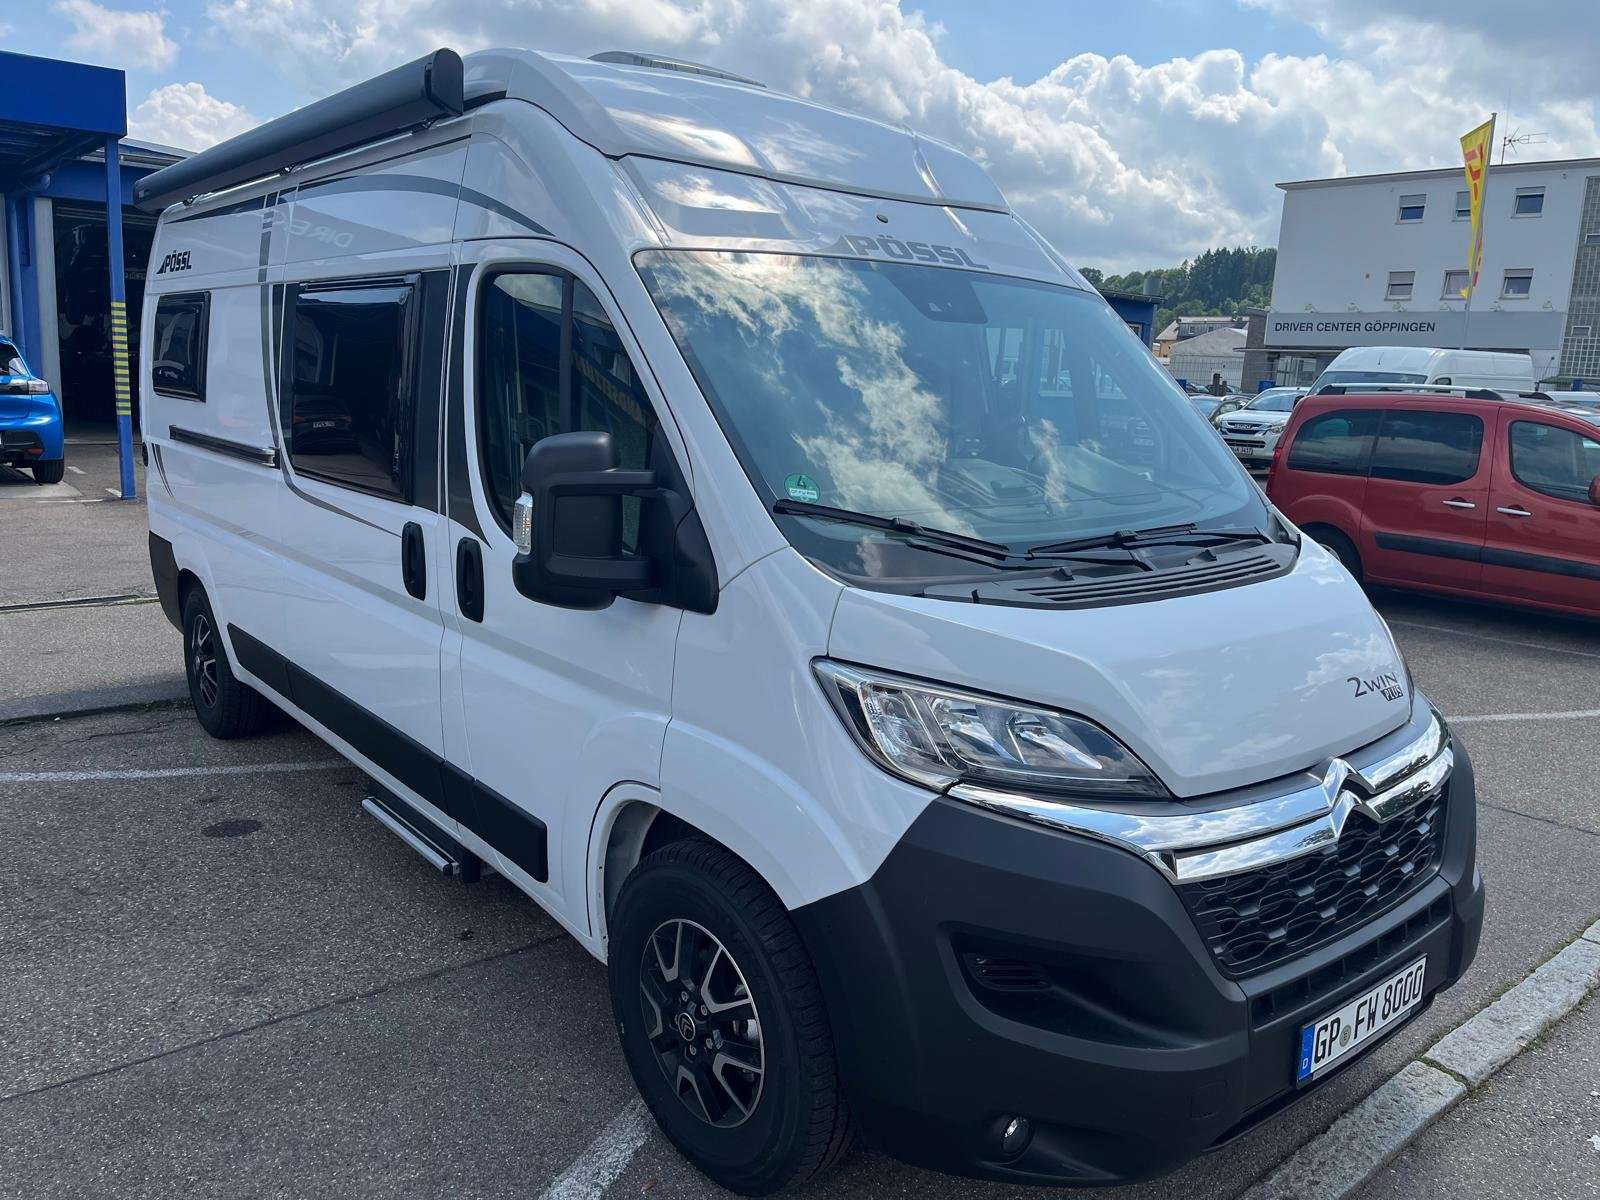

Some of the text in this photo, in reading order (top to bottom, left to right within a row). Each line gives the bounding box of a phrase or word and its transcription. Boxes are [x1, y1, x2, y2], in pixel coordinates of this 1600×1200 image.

[162, 250, 192, 273] PÖSSL
[843, 234, 990, 270] PÖSSL
[1274, 320, 1436, 332] DRIVER CENTER GÖPPINGEN
[1383, 685, 1403, 701] PLUS
[1313, 964, 1424, 1064] GP FW 8000
